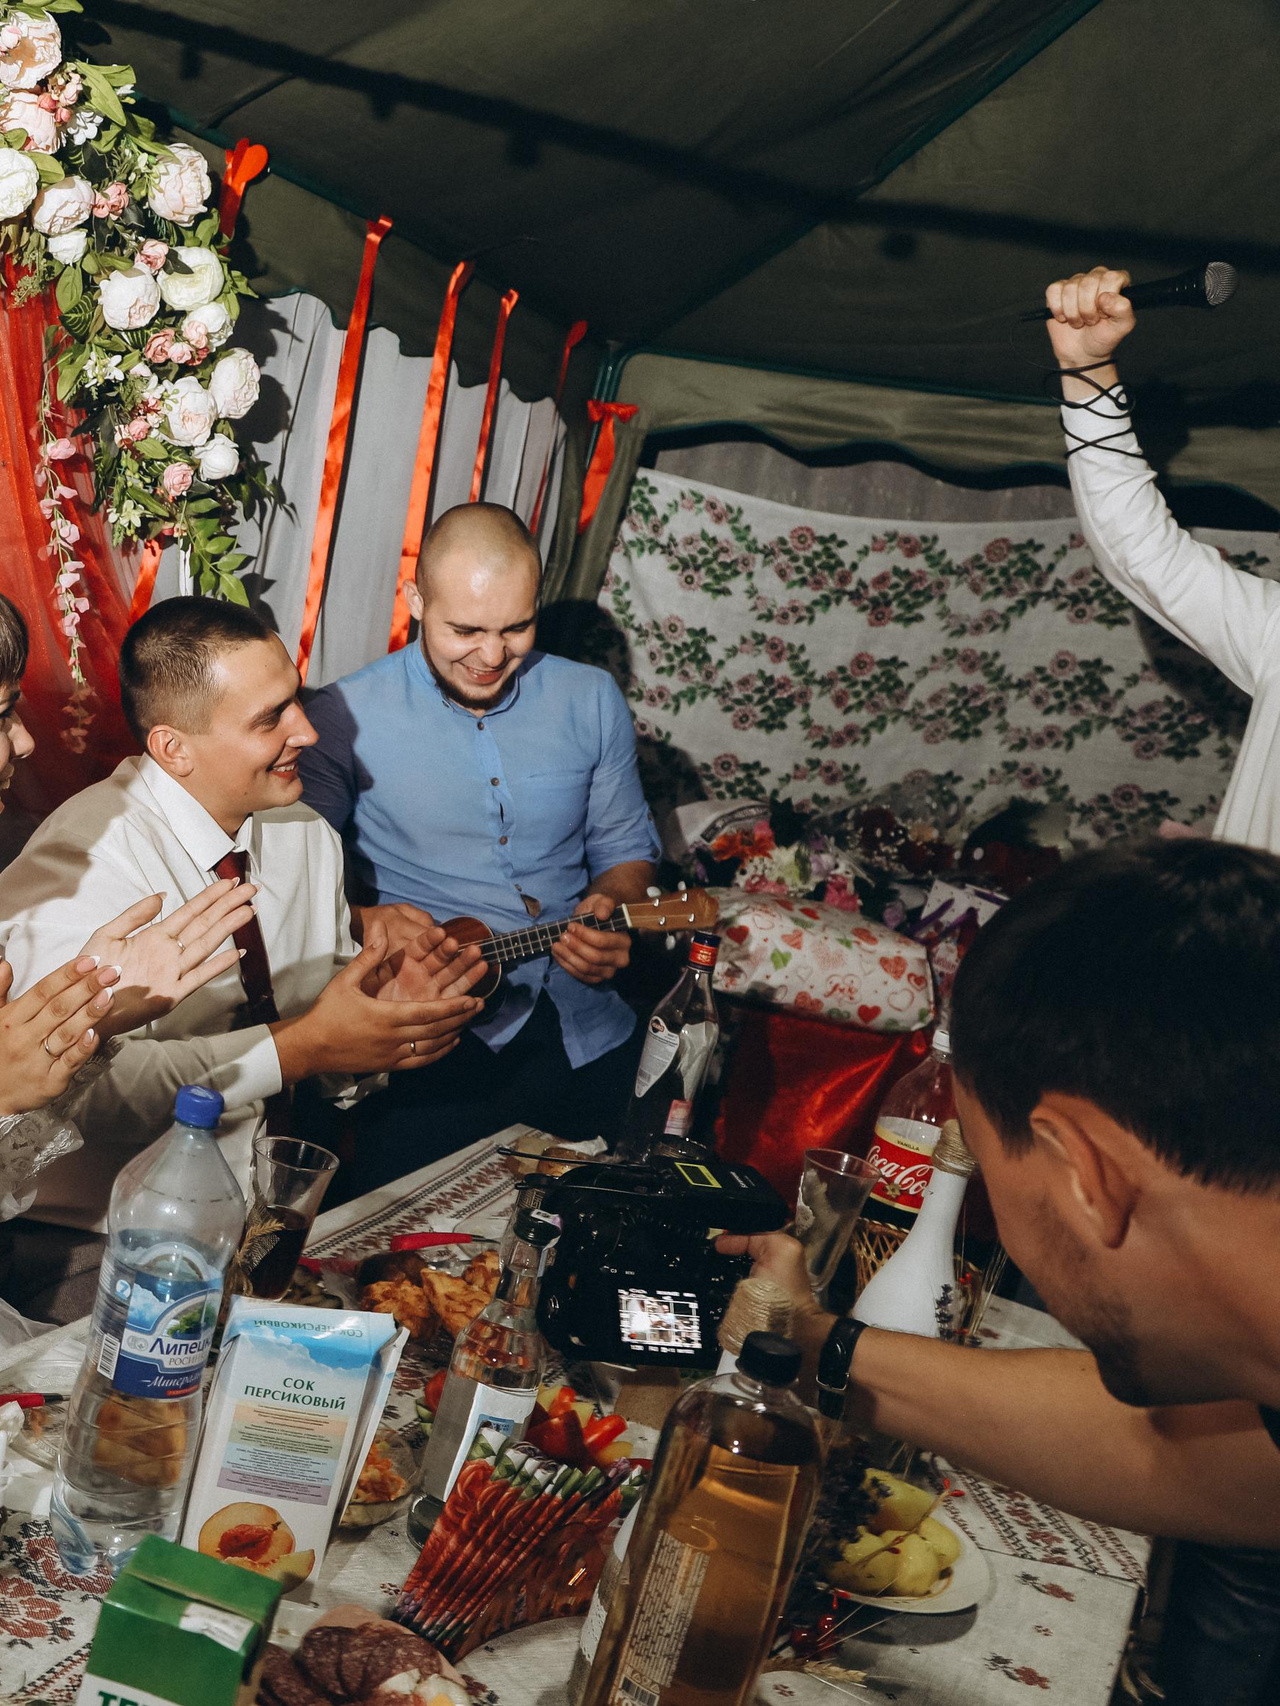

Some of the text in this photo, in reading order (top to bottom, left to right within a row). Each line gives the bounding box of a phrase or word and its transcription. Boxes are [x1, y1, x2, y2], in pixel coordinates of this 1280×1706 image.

[897, 1140, 920, 1152] VANILLA
[866, 1145, 934, 1197] Coca-Co
[283, 1377, 316, 1392] СОК
[244, 1385, 346, 1411] ПЕРСИКОВЫЙ
